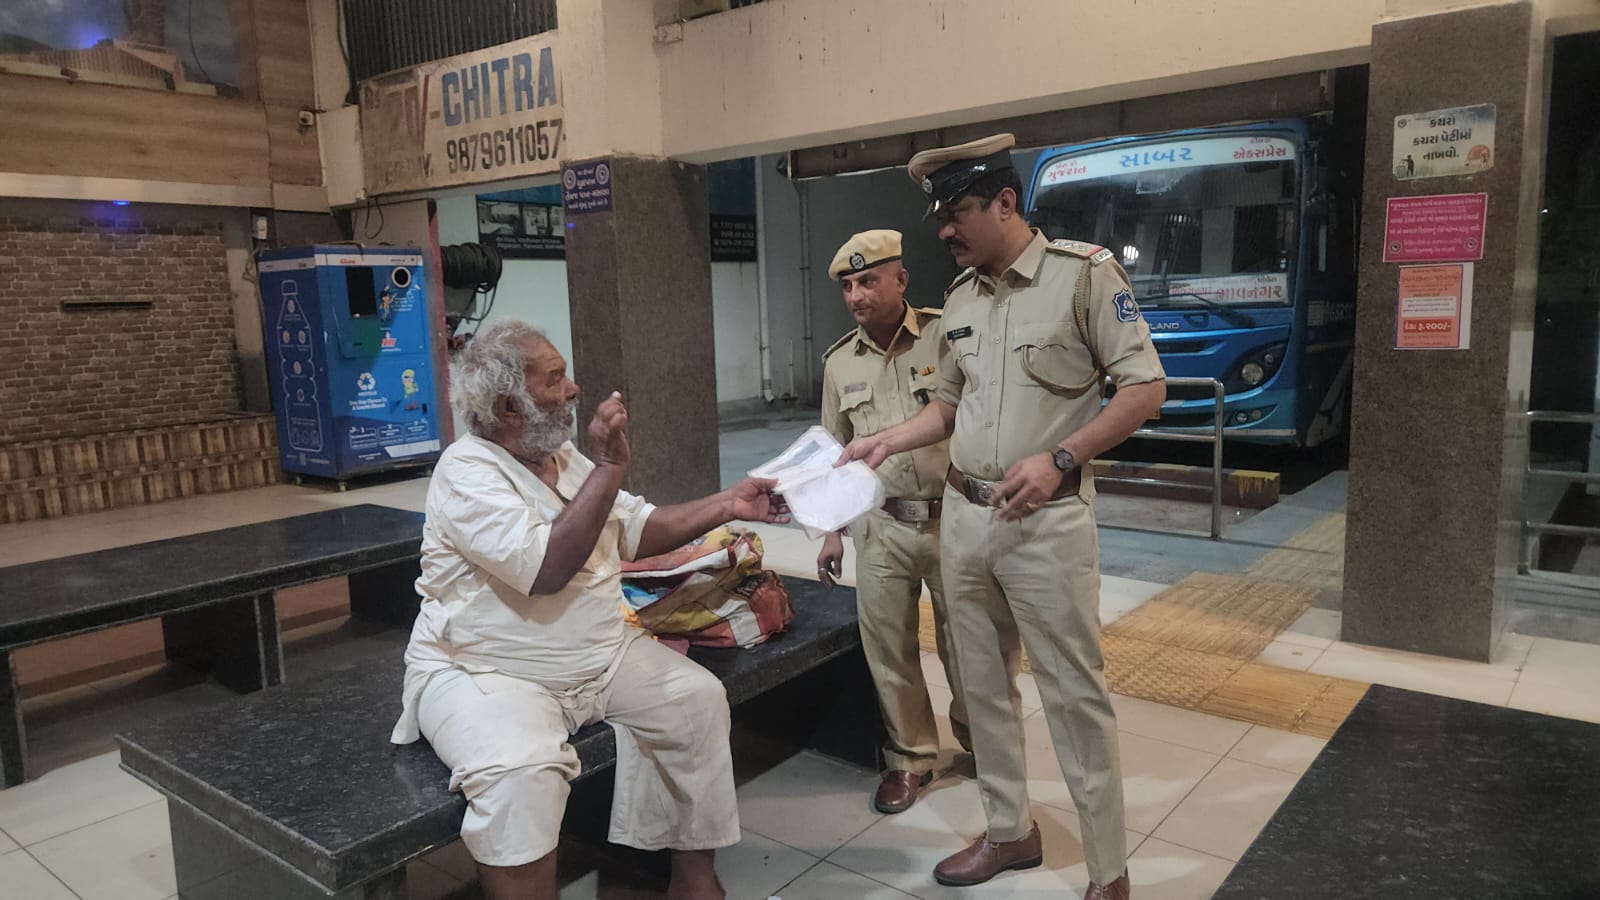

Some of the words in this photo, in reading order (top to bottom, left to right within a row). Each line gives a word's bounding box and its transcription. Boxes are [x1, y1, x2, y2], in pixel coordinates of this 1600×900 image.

[442, 47, 557, 127] CHITRA
[446, 118, 563, 174] 9879611057
[1413, 135, 1439, 146] કચરા
[1120, 147, 1192, 168] સાબર
[1149, 322, 1180, 330] LAND
